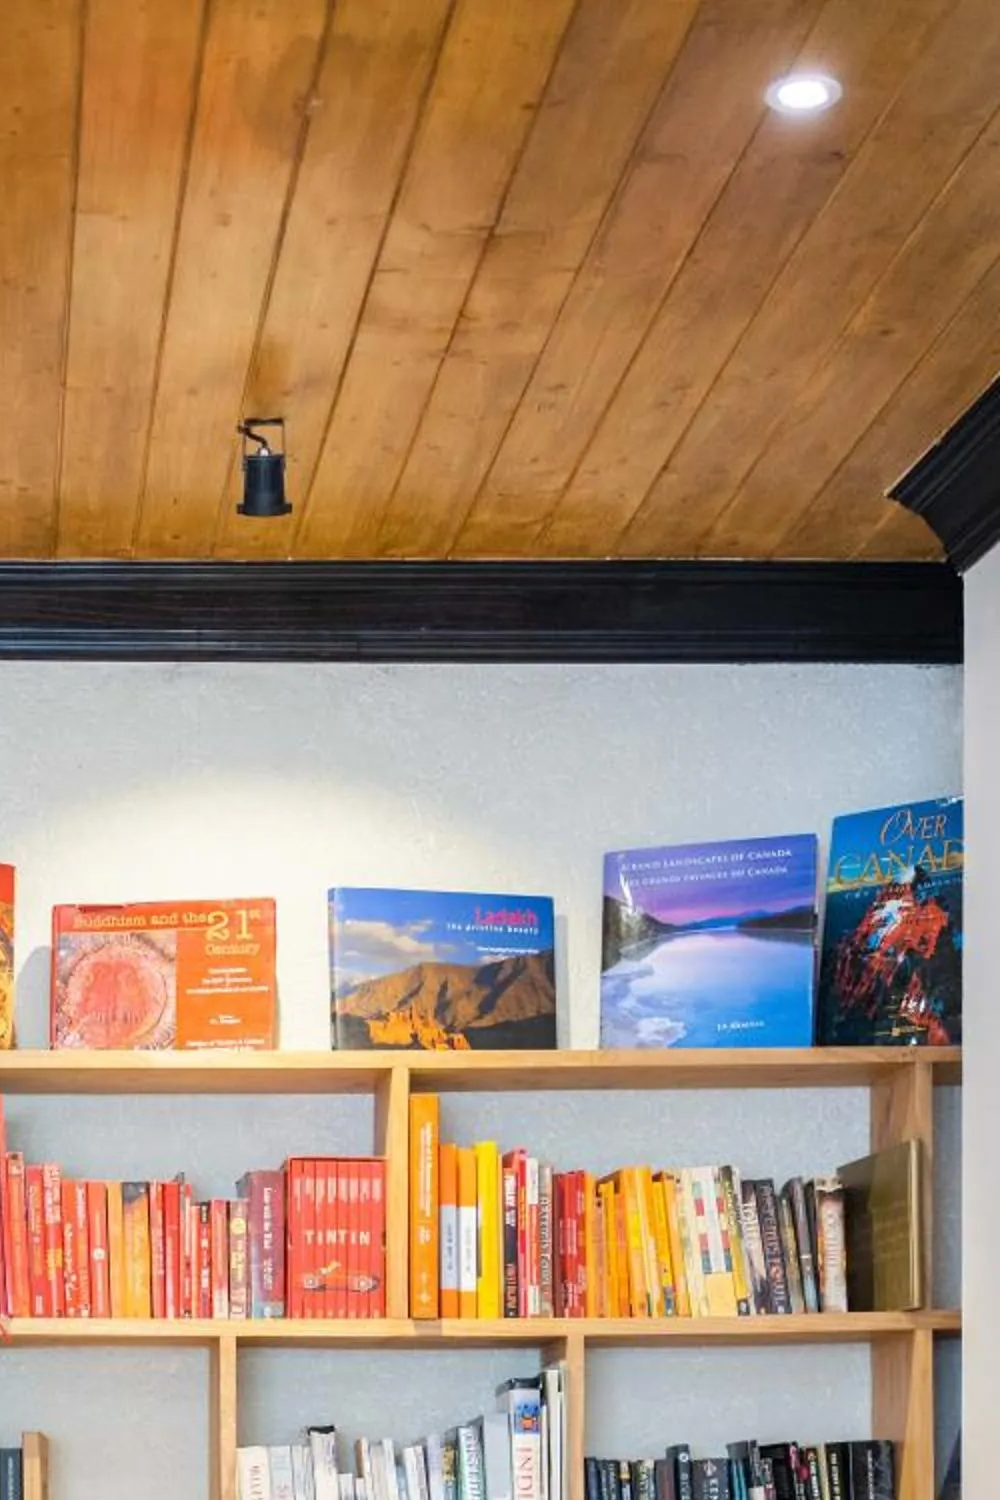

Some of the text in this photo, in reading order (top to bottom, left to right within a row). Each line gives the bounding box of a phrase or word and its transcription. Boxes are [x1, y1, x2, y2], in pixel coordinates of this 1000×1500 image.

[880, 808, 947, 845] OVER
[833, 840, 964, 886] CANAD
[304, 1229, 371, 1246] TINTIN
